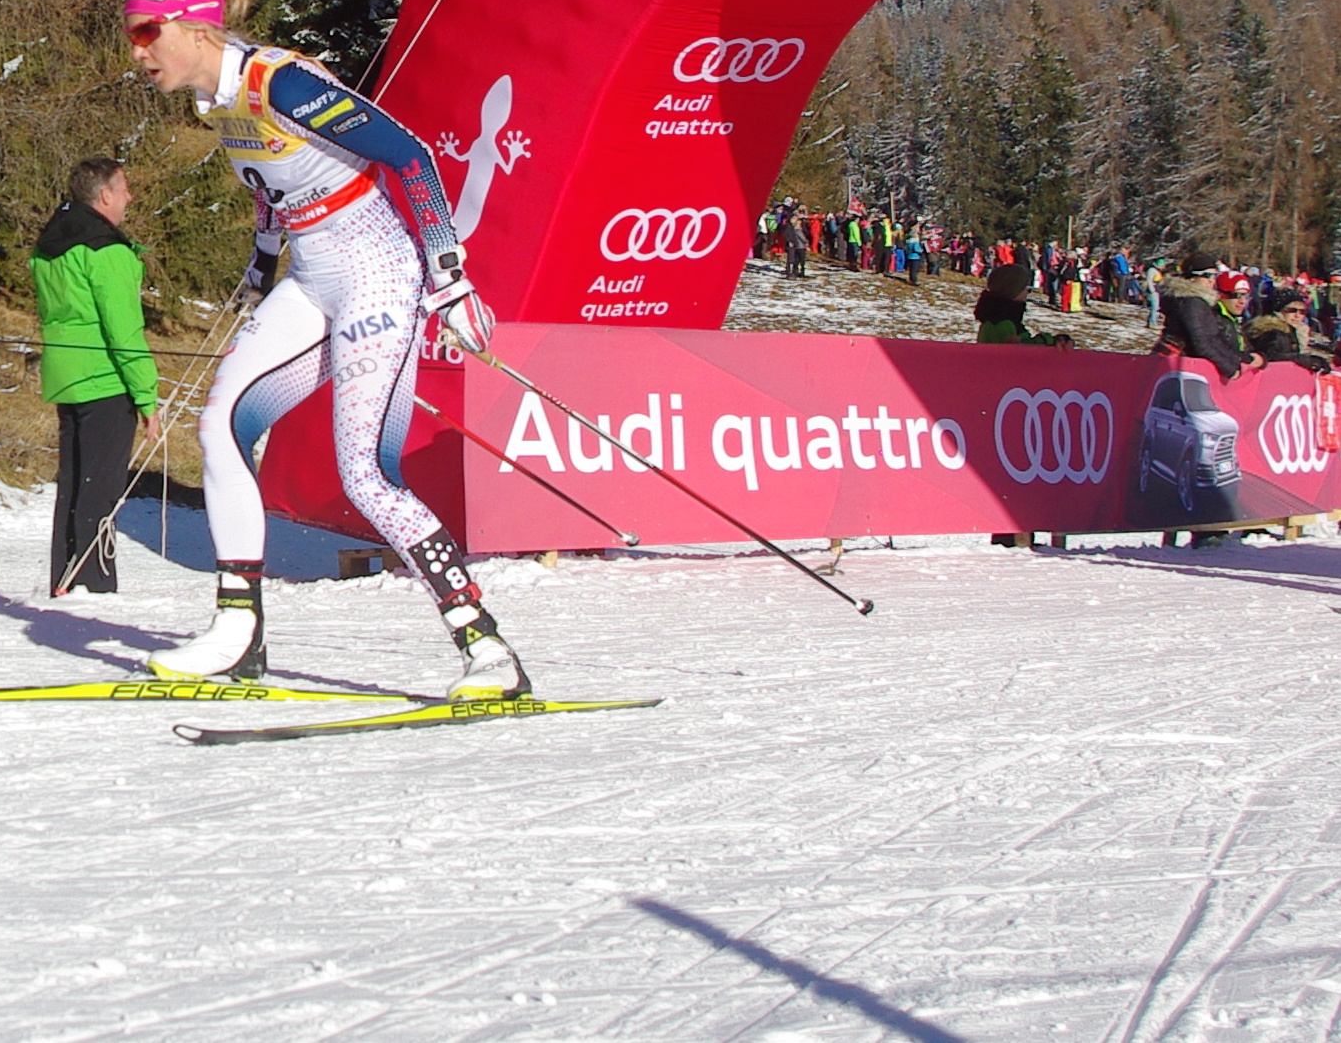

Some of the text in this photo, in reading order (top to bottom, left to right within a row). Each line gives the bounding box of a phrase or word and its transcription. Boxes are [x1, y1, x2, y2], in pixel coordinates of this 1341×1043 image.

[292, 93, 329, 119] CRAFT
[653, 94, 713, 112] Audi
[644, 119, 734, 139] quattro
[586, 275, 646, 294] Audi
[579, 301, 669, 322] quattro
[340, 311, 398, 344] VISA
[498, 391, 968, 491] Audi quattro
[444, 566, 468, 591] 8
[111, 684, 270, 700] FISCHER
[451, 702, 547, 718] FISCHER
